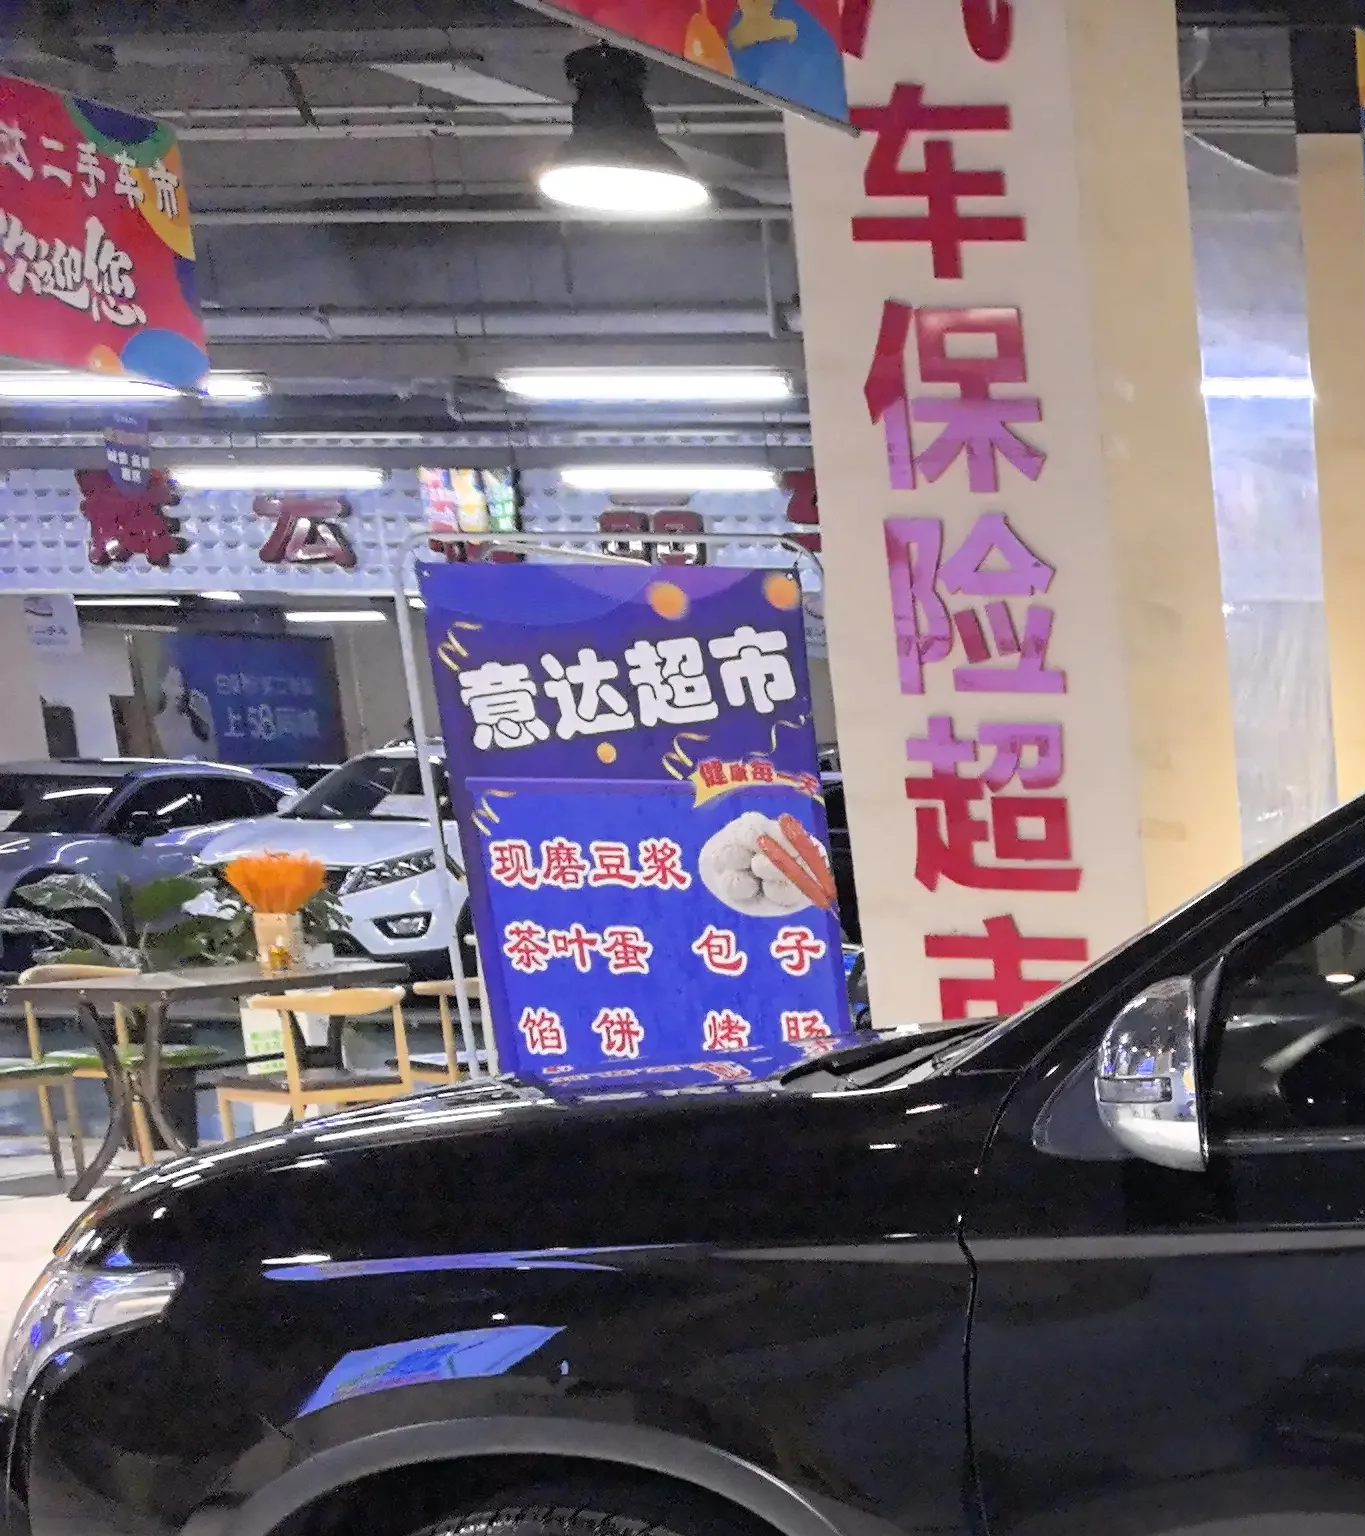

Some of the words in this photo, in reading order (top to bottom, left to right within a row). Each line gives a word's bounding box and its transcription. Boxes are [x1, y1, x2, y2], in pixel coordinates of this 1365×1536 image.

[458, 626, 797, 752] 意达超市
[489, 840, 692, 892] 现磨豆浆
[504, 923, 653, 977] 茶叶蛋
[693, 929, 826, 978] 包子
[519, 1008, 644, 1057] 馅饼
